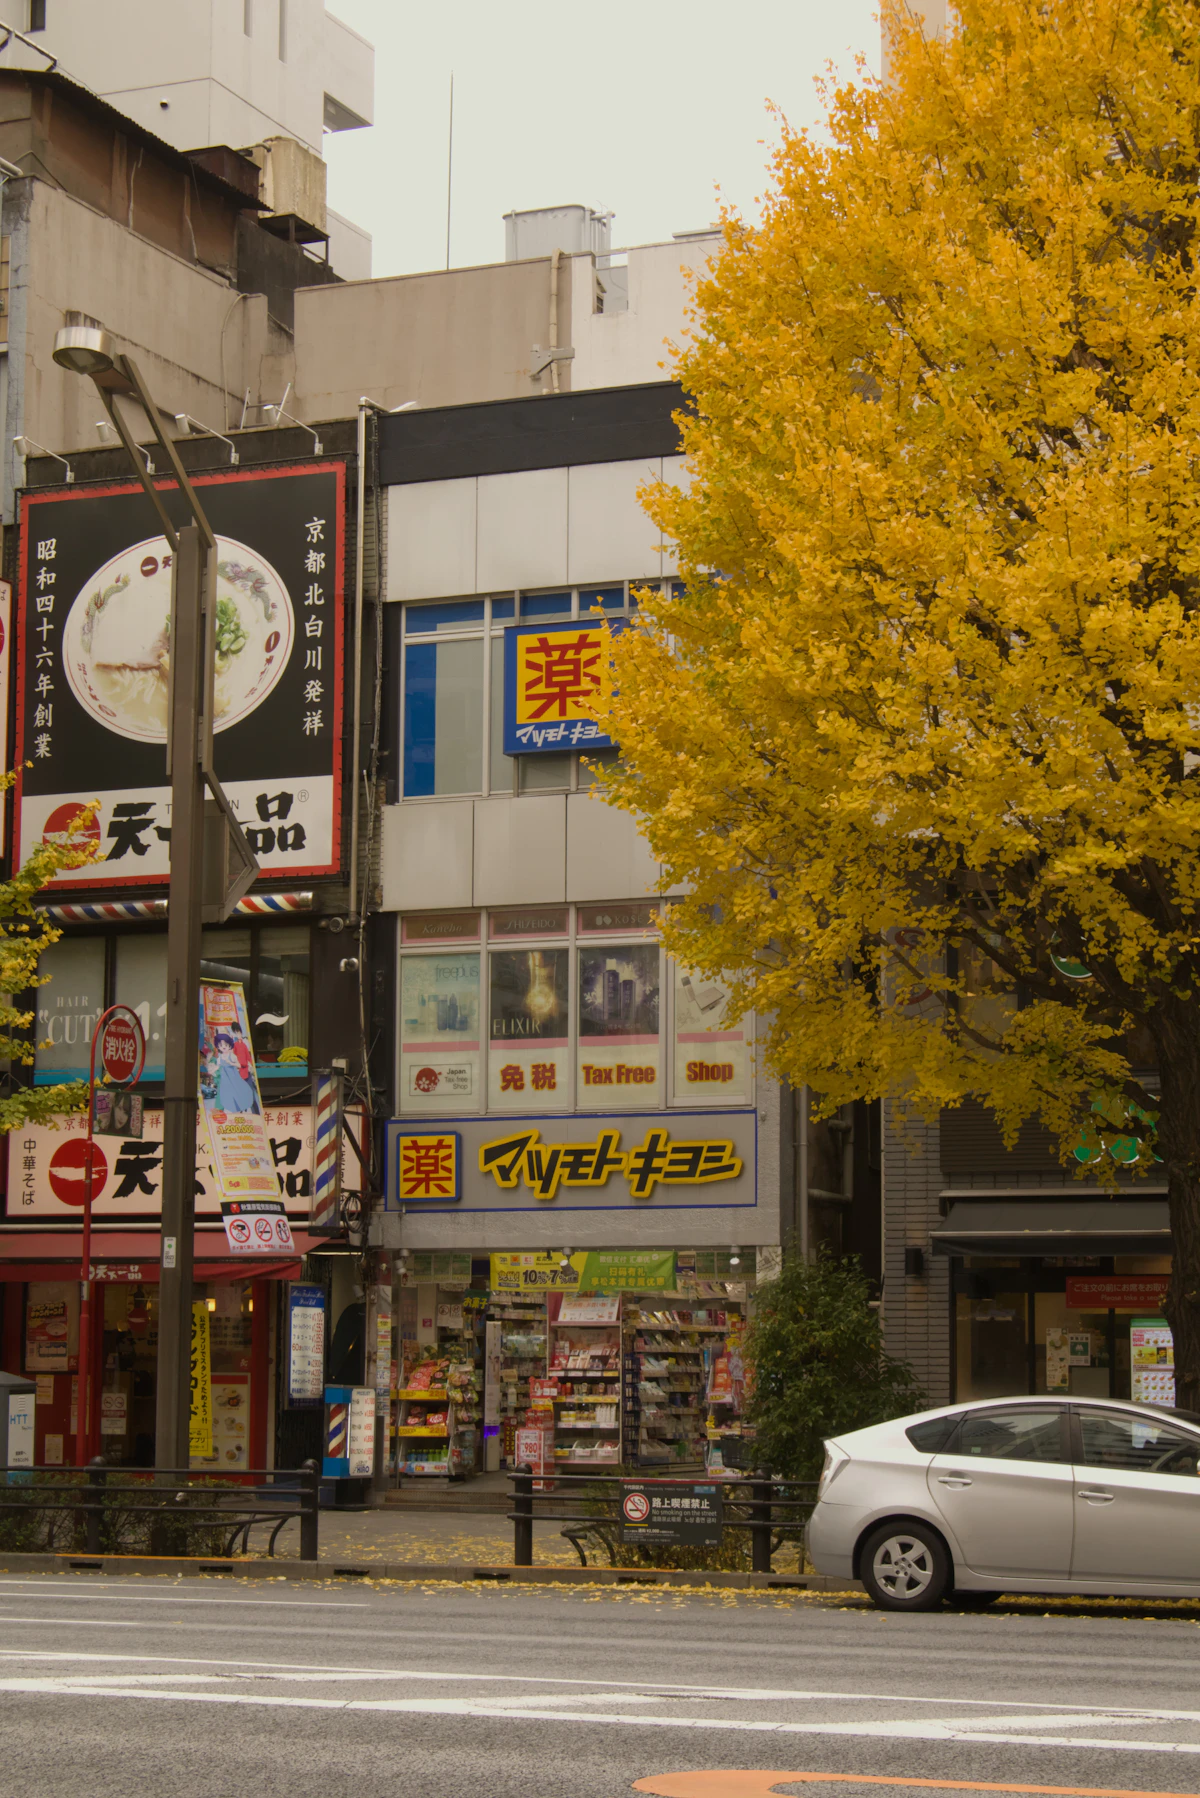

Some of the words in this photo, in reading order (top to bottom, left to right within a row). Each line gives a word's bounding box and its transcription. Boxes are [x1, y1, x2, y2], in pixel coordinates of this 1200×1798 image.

[303, 516, 326, 738] 京都北白川発祥
[33, 537, 58, 760] 昭和四十六年創業
[525, 633, 602, 720] 薬
[422, 923, 463, 935] Kanebo
[503, 918, 556, 930] SHISEIDO
[435, 963, 479, 983] freeplus
[56, 995, 89, 1008] HAIR
[108, 1024, 117, 1032] FIRE
[117, 1025, 134, 1034] HYDRANT
[493, 1016, 542, 1036] ELIXIR
[104, 1036, 136, 1063] 消火栓
[444, 1076, 468, 1084] Tax-free
[500, 1062, 557, 1092] 免税
[582, 1065, 614, 1085] Tax
[616, 1064, 656, 1084] Free
[686, 1061, 734, 1083] Shop
[452, 1083, 468, 1091] Shop
[22, 1137, 37, 1206] 中華そば
[402, 1138, 453, 1195] 薬
[481, 1130, 741, 1197] マツモトキヨシ
[96, 1264, 142, 1281] 天下一品
[609, 1267, 646, 1277] 扫码有礼
[463, 1296, 488, 1310] お菓子
[9, 1413, 28, 1425] HTT
[524, 1442, 538, 1454] 980
[652, 1497, 710, 1509] 路上喫煙禁止
[660, 1509, 683, 1517] smoking
